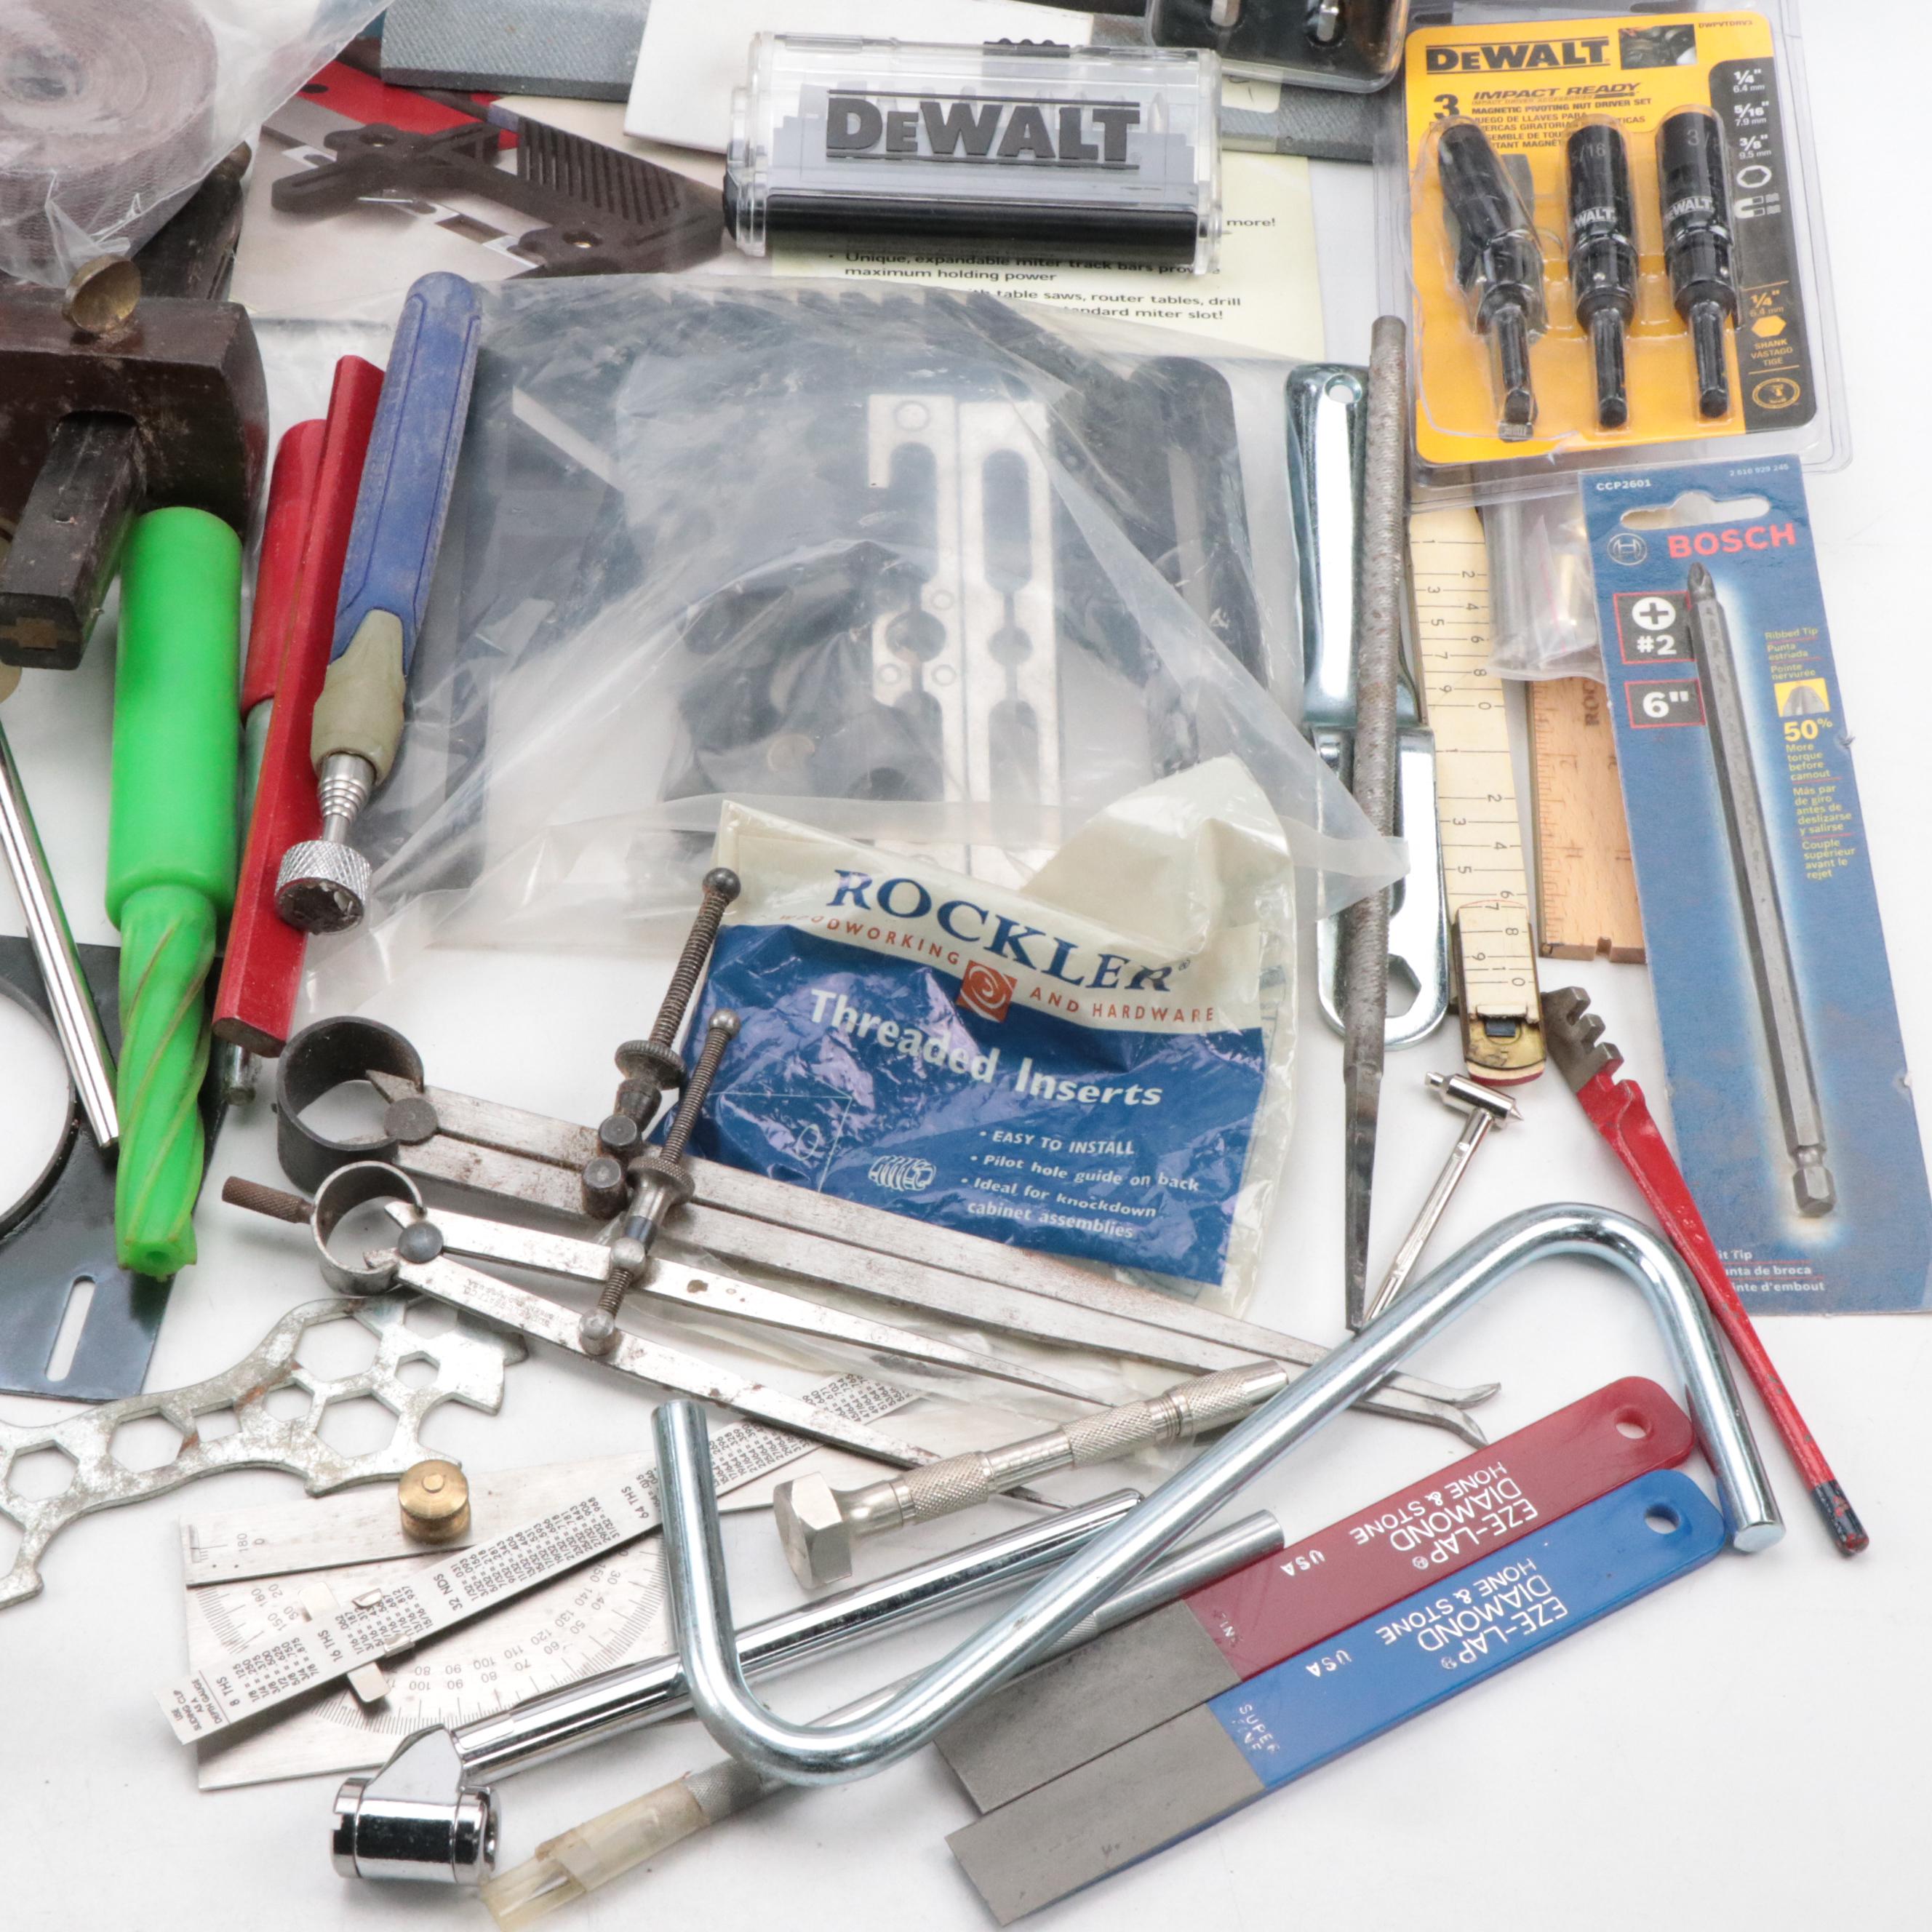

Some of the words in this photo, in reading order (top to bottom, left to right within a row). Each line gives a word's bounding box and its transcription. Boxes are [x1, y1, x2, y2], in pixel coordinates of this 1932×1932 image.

[1473, 88, 1560, 100] IMPACT
[1566, 82, 1641, 95] READY
[1733, 84, 1748, 93] 6.4
[1434, 94, 1460, 119] 3
[1472, 106, 1522, 114] MAGNETIC
[1525, 103, 1570, 112] PIVOTING
[1573, 102, 1592, 110] NUT
[1594, 100, 1630, 108] DRIVER
[1633, 97, 1652, 105] SET
[1522, 113, 1559, 121] LLAVES
[1735, 118, 1749, 127] 7.9
[1739, 151, 1754, 159] 9.5
[1226, 217, 1275, 227] more!
[845, 252, 910, 265] Unique,
[914, 255, 1010, 266] expandable
[1017, 258, 1060, 268] miter
[1069, 259, 1112, 270] track
[1117, 262, 1153, 272] bars
[845, 267, 932, 277] maximum
[937, 269, 999, 282] holding
[1005, 272, 1057, 282] power
[997, 290, 1038, 300] table
[1043, 292, 1087, 302] saws,
[1091, 293, 1145, 303] router
[1150, 295, 1205, 306] tables,
[1208, 297, 1241, 306] drill
[1135, 308, 1183, 319] miter
[1188, 309, 1224, 319] slot!
[1768, 306, 1784, 315] mm
[1755, 338, 1788, 350] SHANK
[1763, 357, 1783, 366] TIGE
[1596, 479, 1651, 491] CCP2601
[1667, 523, 1796, 559] BOSCH
[1461, 570, 1474, 578] 2
[1427, 586, 1441, 594] 3
[1466, 603, 1480, 611] 4
[1431, 618, 1445, 626] 5
[1764, 628, 1800, 640] Ribbed
[1803, 627, 1818, 636] Tip
[1637, 634, 1677, 655] #2
[1767, 643, 1796, 652] Punta
[1434, 651, 1448, 660] 7
[1473, 668, 1487, 676] 8
[1771, 664, 1803, 674] Pointe
[1642, 690, 1689, 718] 6"
[1784, 718, 1833, 742] 50%
[1786, 743, 1814, 753] More
[1787, 752, 1823, 762] torque
[1789, 761, 1824, 771] before
[1790, 770, 1831, 781] camout
[1792, 786, 1816, 796] Más
[1819, 785, 1837, 796] par
[1795, 797, 1808, 806] de
[1811, 795, 1832, 806] giro
[1796, 806, 1826, 815] antes
[1829, 803, 1842, 812] de
[1797, 813, 1851, 825] deslizarse
[1800, 826, 1805, 836] y
[1808, 823, 1844, 834] salirse
[1802, 838, 1840, 850] Couple
[1803, 847, 1855, 861] supérieur
[1805, 859, 1835, 869] avant
[1838, 858, 1848, 866] le
[1806, 869, 1832, 880] rejet
[826, 869, 1173, 991] ROCKLER
[1029, 987, 1079, 1013] AND
[1092, 1002, 1214, 1023] HARDWARE
[810, 989, 1000, 1083] Threaded
[1015, 1057, 1163, 1106] Inserts
[992, 1130, 1035, 1145] EASY
[1041, 1137, 1062, 1151] TO
[1069, 1141, 1135, 1155] INSTALL
[983, 1154, 1024, 1169] Pilot
[1031, 1162, 1068, 1179] hole
[1074, 1169, 1123, 1185] guide
[1130, 1175, 1150, 1186] on
[1158, 1172, 1199, 1192] back
[974, 1178, 1017, 1195] Ideal
[1024, 1185, 1050, 1200] for
[1056, 1193, 1157, 1218] knockdown
[967, 1201, 1031, 1221] cabinet
[1038, 1210, 1133, 1239] assemblies
[1718, 1250, 1728, 1259] it
[1732, 1249, 1753, 1261] Tip
[1754, 1265, 1770, 1276] de
[1773, 1265, 1812, 1275] broca
[1760, 1282, 1826, 1292] d'embout
[1444, 1461, 1508, 1499] HONE
[620, 1484, 639, 1506] THS
[1425, 1490, 1445, 1506] &
[634, 1504, 650, 1520] 64
[1389, 1477, 1522, 1552] DIAMOND
[1349, 1498, 1426, 1546] STONE
[1280, 1549, 1326, 1577] USA
[433, 1571, 452, 1596] NDS
[1473, 1558, 1536, 1597] HONE
[1453, 1588, 1473, 1605] &
[447, 1596, 463, 1612] 32
[1375, 1595, 1456, 1645] STONE
[1416, 1575, 1553, 1652] DIAMOND
[317, 1628, 335, 1649] THS
[330, 1648, 343, 1662] 16
[1305, 1649, 1352, 1678] USA
[191, 1677, 210, 1704] GAUGE
[215, 1674, 233, 1696] THS
[172, 1688, 187, 1704] CLIP
[190, 1696, 199, 1704] A
[228, 1697, 241, 1707] 8
[247, 1688, 260, 1703] 1/8
[171, 1707, 183, 1721] USE
[193, 1702, 204, 1714] AS
[205, 1701, 223, 1725] DEPTH
[181, 1703, 201, 1732] SLIDING
